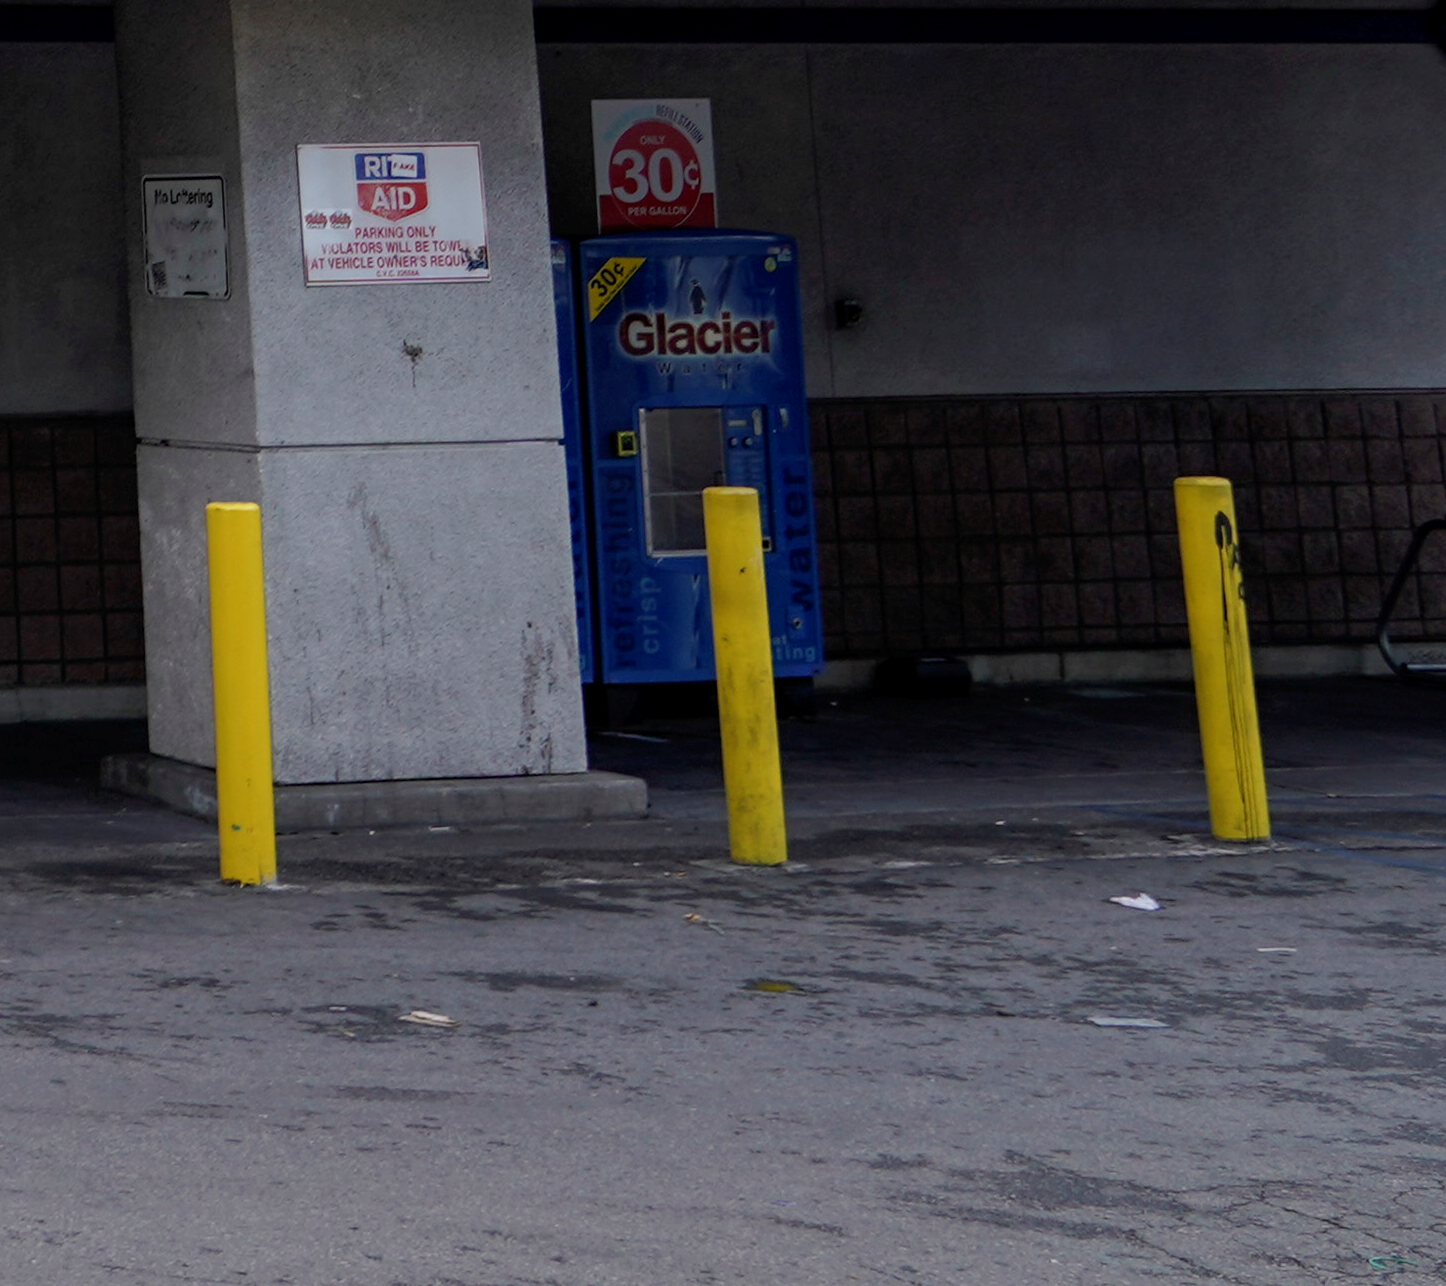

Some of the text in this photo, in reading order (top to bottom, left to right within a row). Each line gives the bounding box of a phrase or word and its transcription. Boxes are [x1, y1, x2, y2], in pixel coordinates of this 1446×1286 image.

[640, 135, 666, 145] ONLY
[677, 115, 705, 144] STATION
[611, 147, 700, 204] 30¢
[371, 186, 417, 211] AID
[628, 206, 687, 217] PER GALLON
[354, 225, 437, 239] PARKING ONLY
[385, 240, 412, 253] WILL
[414, 240, 430, 253] BE
[311, 257, 326, 270] AT
[328, 256, 374, 269] VEHICLE
[376, 255, 427, 268] OWNER'S
[590, 260, 626, 297] 30¢
[619, 311, 775, 355] Glacier
[657, 362, 747, 375] Water
[783, 467, 813, 613] water
[603, 466, 637, 670] refreshing
[638, 576, 662, 655] crisp
